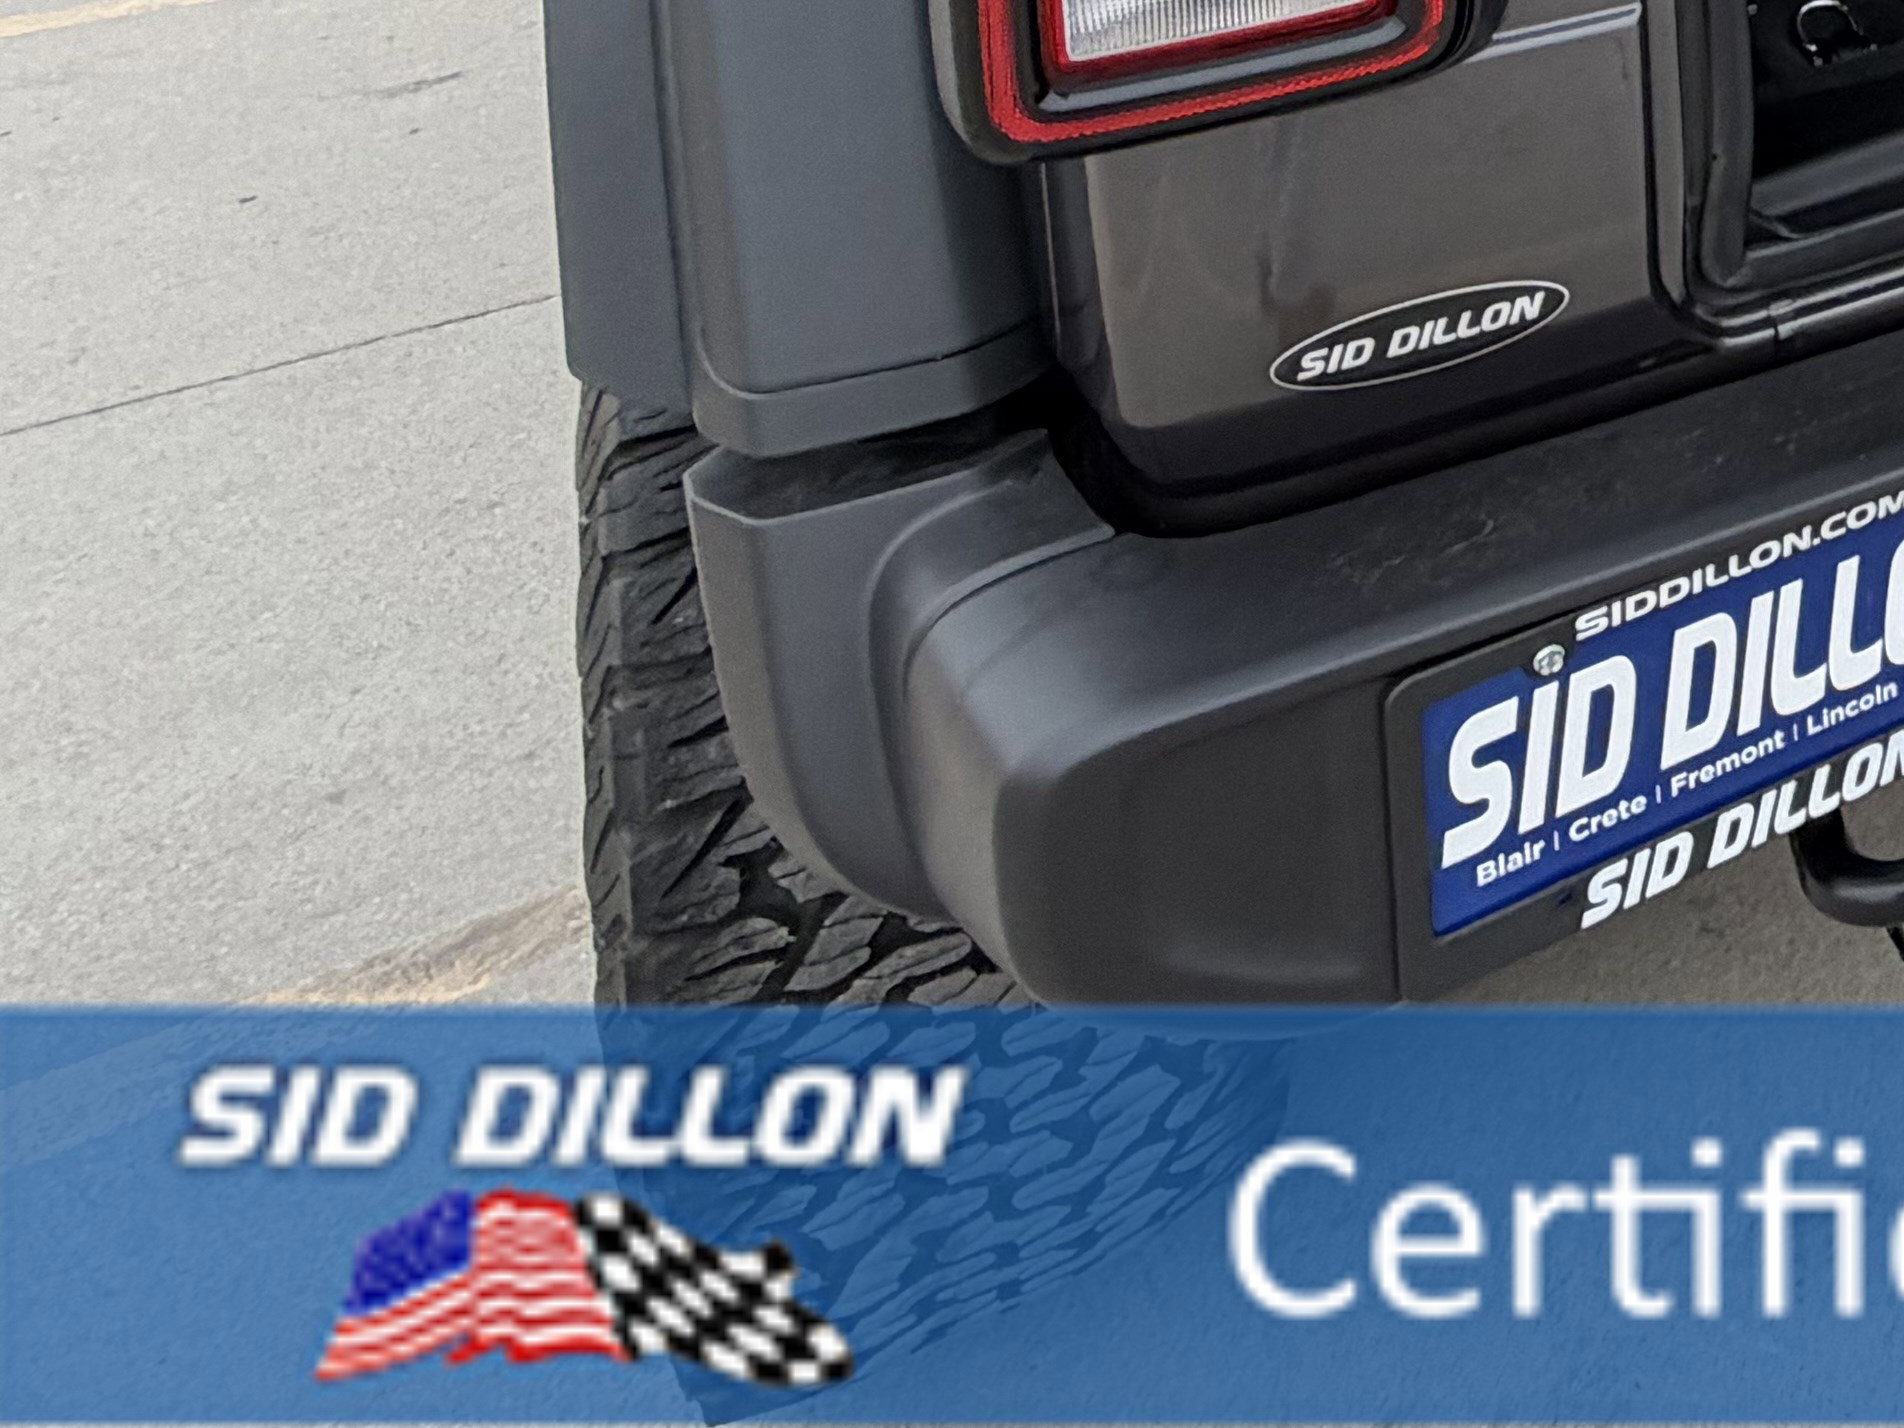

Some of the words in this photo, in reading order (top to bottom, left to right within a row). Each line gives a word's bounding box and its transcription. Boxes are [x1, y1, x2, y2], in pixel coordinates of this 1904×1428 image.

[1296, 337, 1376, 382] SID
[1386, 290, 1546, 359] DILLON
[1441, 654, 1638, 870] SID
[1475, 833, 1546, 888] Blair
[1568, 793, 1648, 842] Crete
[1669, 730, 1786, 798] Fremont
[1805, 678, 1899, 737] Lincoln
[1580, 825, 1696, 930] SID
